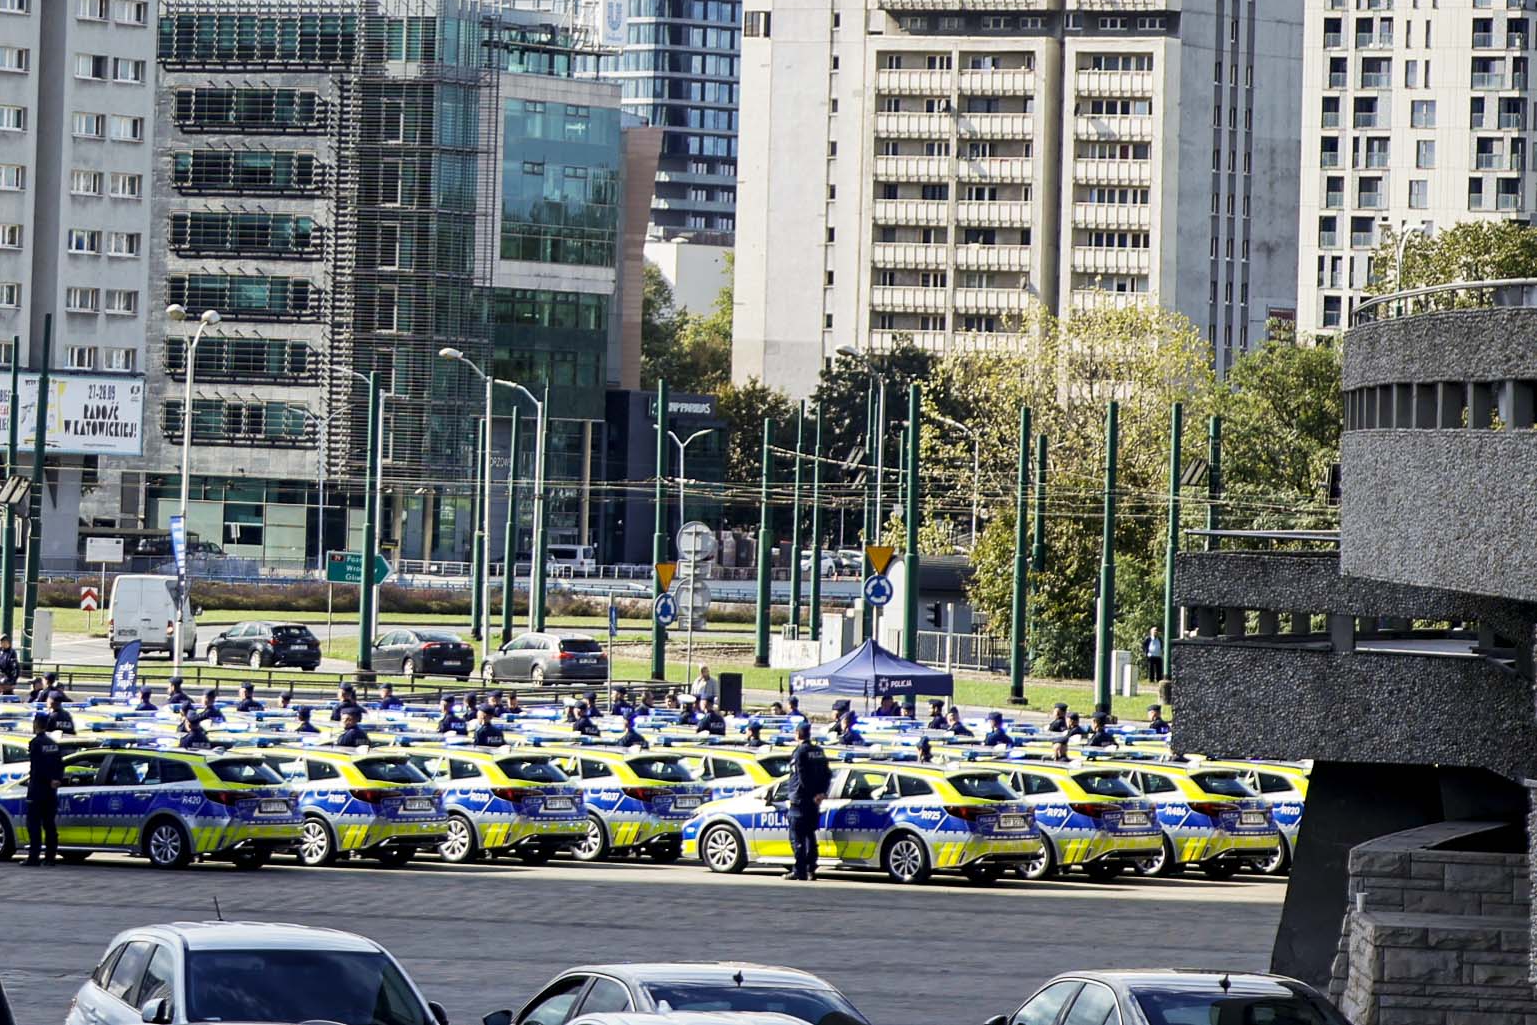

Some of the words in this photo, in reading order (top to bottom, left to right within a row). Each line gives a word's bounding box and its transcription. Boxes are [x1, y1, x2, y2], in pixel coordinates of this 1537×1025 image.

[84, 401, 119, 420] RADOŚĆ
[64, 420, 71, 435] W
[74, 420, 137, 438] KATOWICKIEJ!
[806, 679, 829, 687] POLICJA
[182, 796, 201, 804] R420
[1047, 808, 1067, 817] R924
